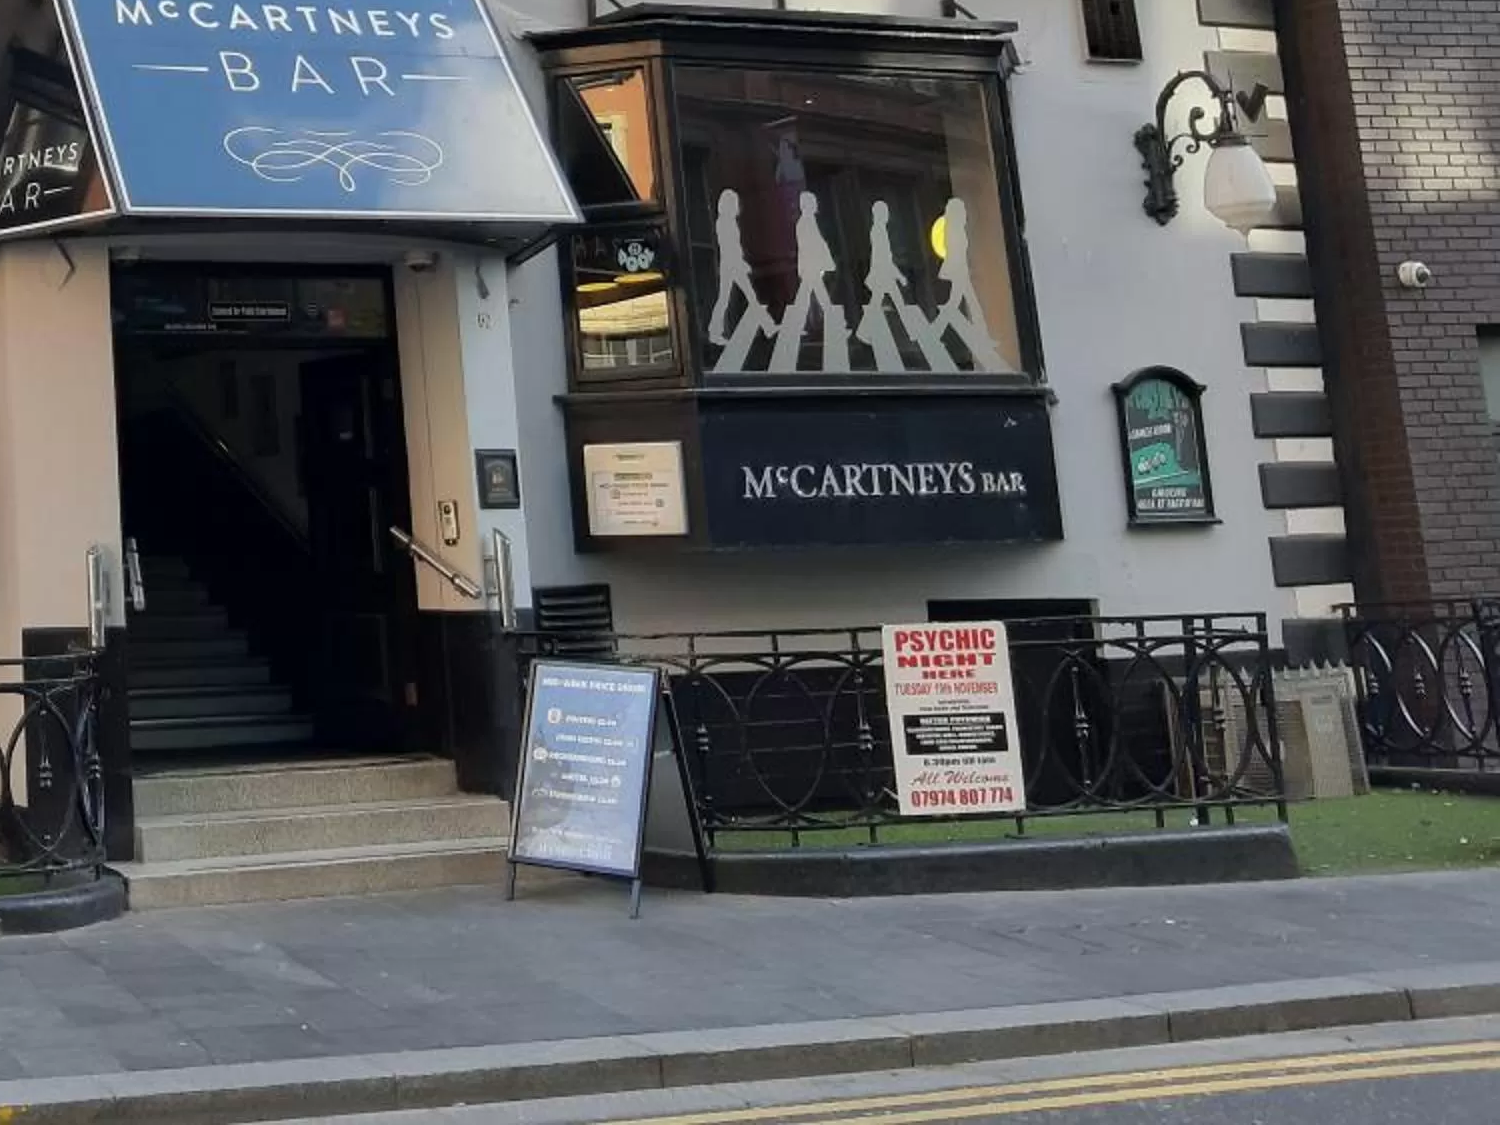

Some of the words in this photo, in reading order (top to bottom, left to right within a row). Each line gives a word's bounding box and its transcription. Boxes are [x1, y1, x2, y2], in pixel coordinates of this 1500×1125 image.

[218, 51, 396, 97] BAR
[741, 460, 976, 502] McCARTNEYS
[981, 472, 1027, 495] BAR
[894, 628, 996, 652] PSYCHIC
[897, 653, 997, 668] NIGHT
[921, 668, 977, 680] HERE
[894, 683, 932, 696] TUESDAY
[954, 681, 998, 695] NOVEMBER
[910, 771, 942, 787] All
[911, 788, 956, 807] 07974
[959, 787, 987, 805] 807
[990, 786, 1014, 803] 774
